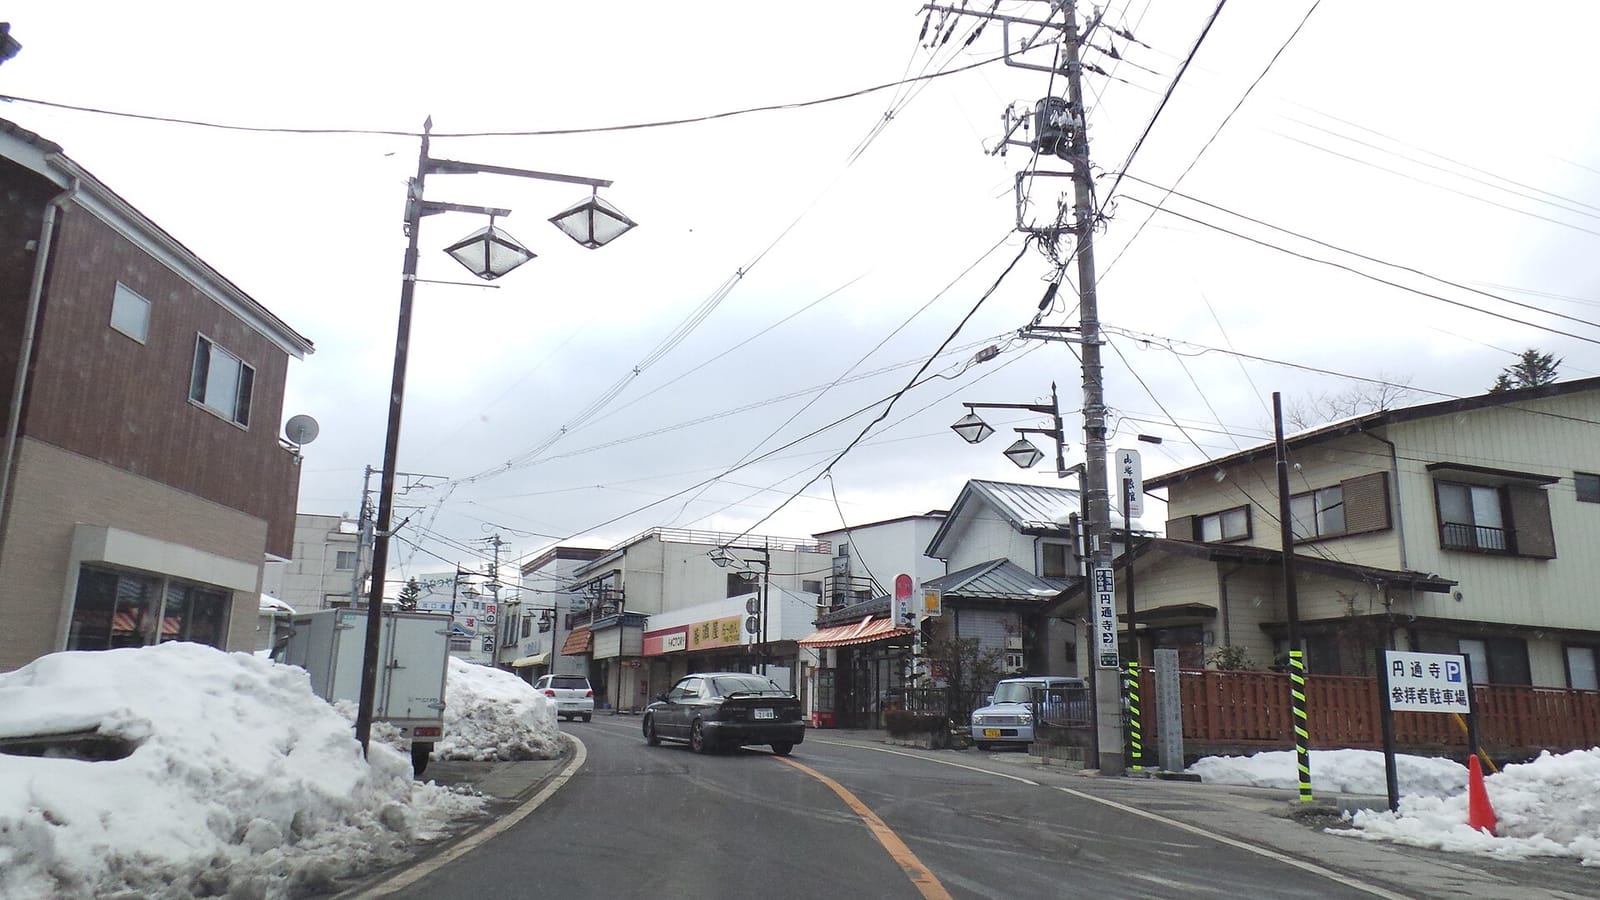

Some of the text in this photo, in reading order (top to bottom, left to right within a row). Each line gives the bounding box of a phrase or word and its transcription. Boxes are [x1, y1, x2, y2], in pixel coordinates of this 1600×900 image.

[1100, 594, 1113, 631] 円通寺
[1392, 660, 1460, 681] 円通寺 P
[1392, 686, 1467, 707] 参拝者駐車場
